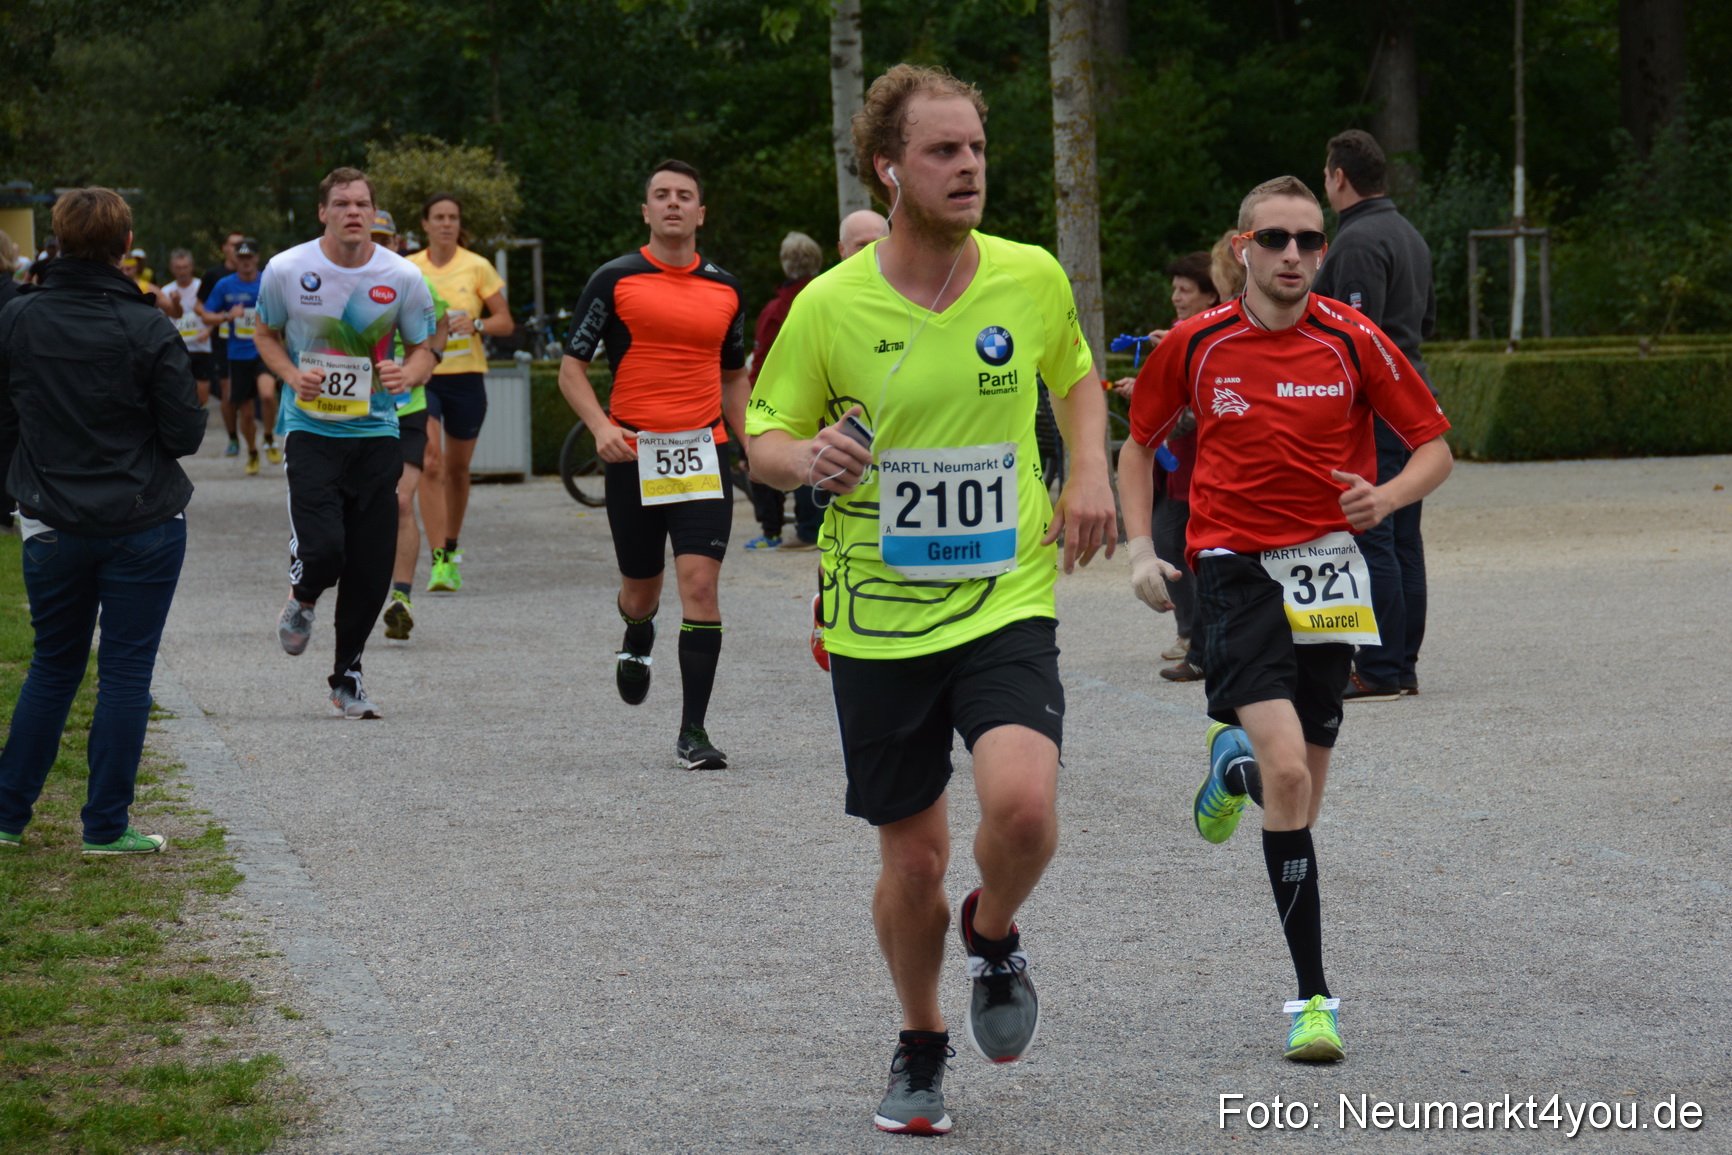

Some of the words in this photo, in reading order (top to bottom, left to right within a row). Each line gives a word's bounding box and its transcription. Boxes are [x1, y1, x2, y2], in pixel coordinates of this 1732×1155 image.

[300, 294, 323, 302] PARTL
[978, 327, 1010, 341] BMW
[301, 357, 325, 367] PARTL
[326, 362, 360, 370] Neumarkt
[978, 369, 1018, 387] Partl
[979, 386, 1018, 396] Neumarkt
[1276, 381, 1344, 397] Marcel
[317, 400, 348, 412] Tobias
[656, 447, 704, 475] 535
[882, 461, 929, 474] PARTL
[933, 459, 999, 474] Neumarkt
[645, 480, 694, 495] George
[896, 476, 1003, 528] 2101
[927, 541, 982, 561] Gerrit
[1264, 548, 1306, 560] PARTL
[1308, 544, 1357, 557] Neumarkt
[1290, 561, 1359, 605] 321
[1309, 611, 1359, 629] Marcel
[1281, 873, 1307, 883] cep
